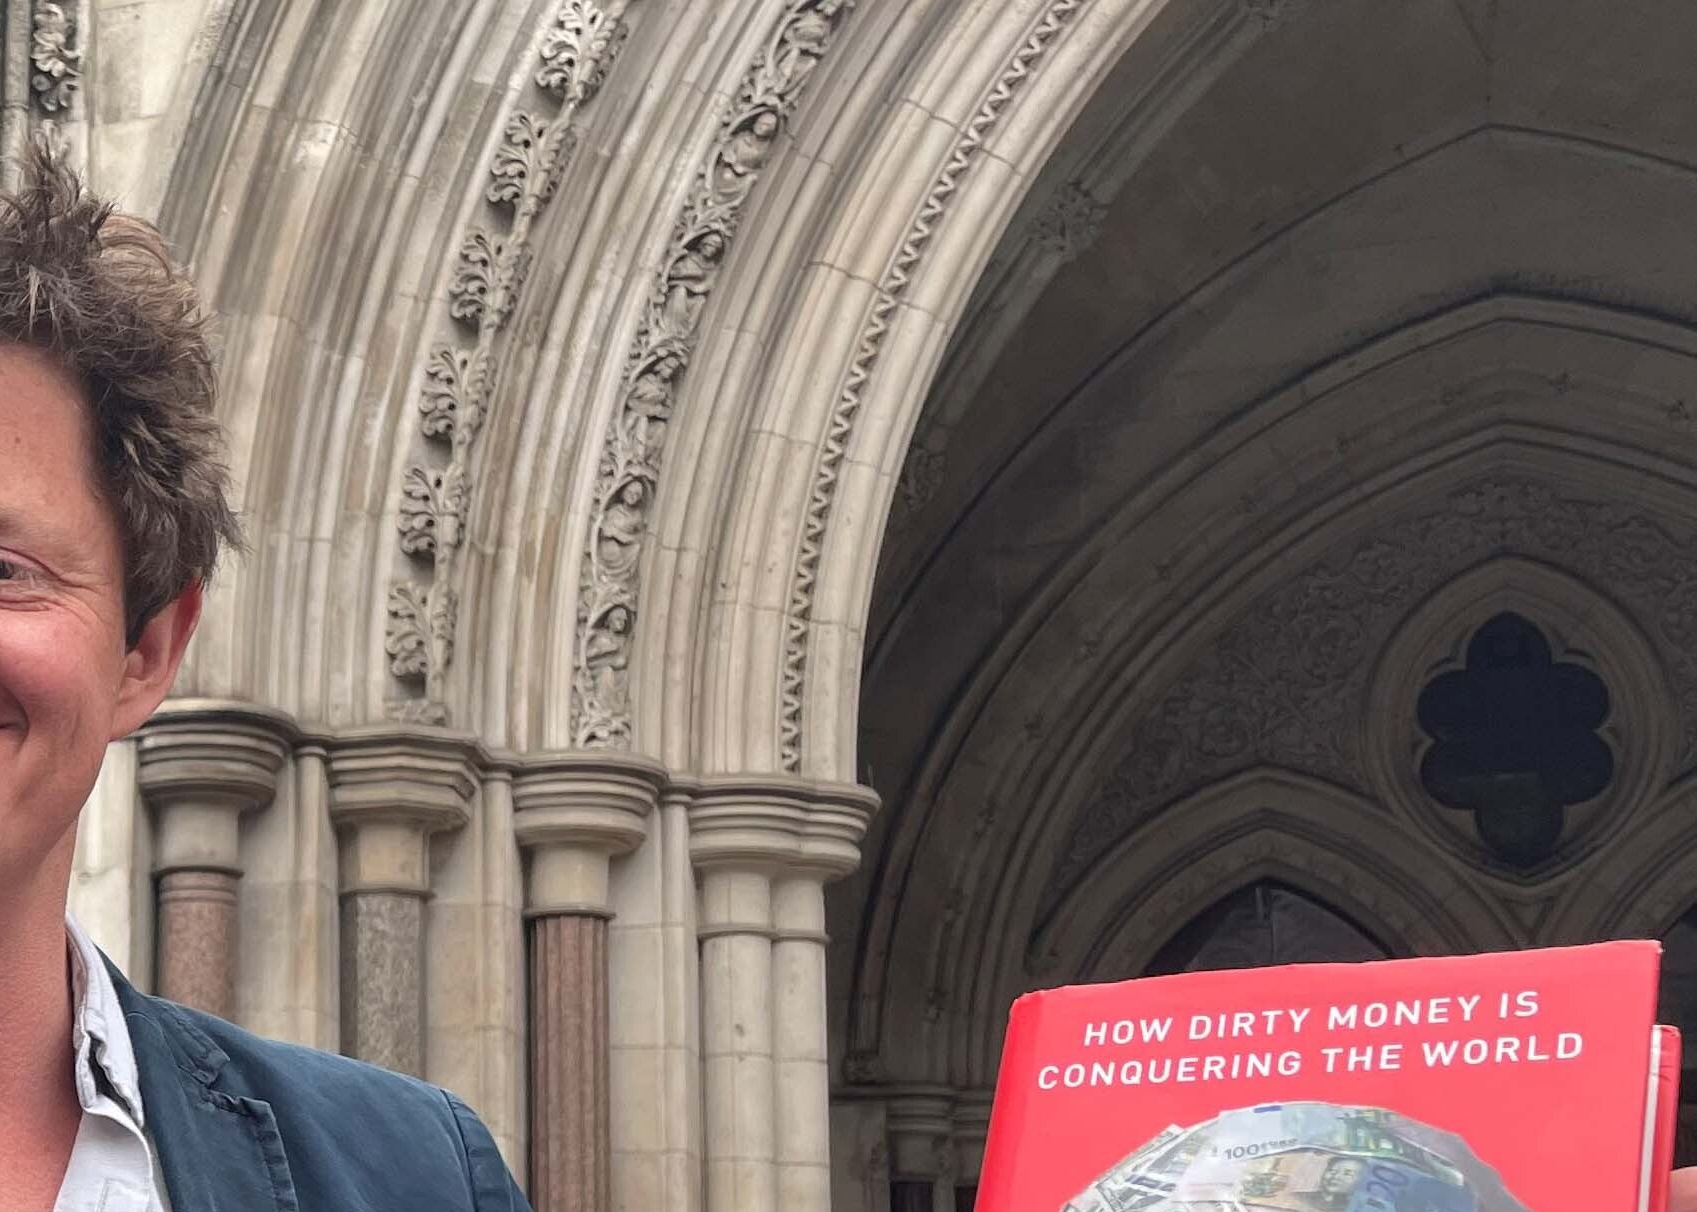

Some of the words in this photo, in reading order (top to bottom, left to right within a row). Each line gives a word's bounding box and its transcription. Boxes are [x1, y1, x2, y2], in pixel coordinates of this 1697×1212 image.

[1084, 1018, 1173, 1047] HOW
[1189, 1008, 1310, 1040] DIRTY
[1328, 995, 1481, 1030] MONEY
[1500, 991, 1539, 1019] IS
[1039, 1051, 1301, 1090] CONQUERING
[1321, 1044, 1402, 1073] THE
[1422, 1033, 1583, 1067] WORLD
